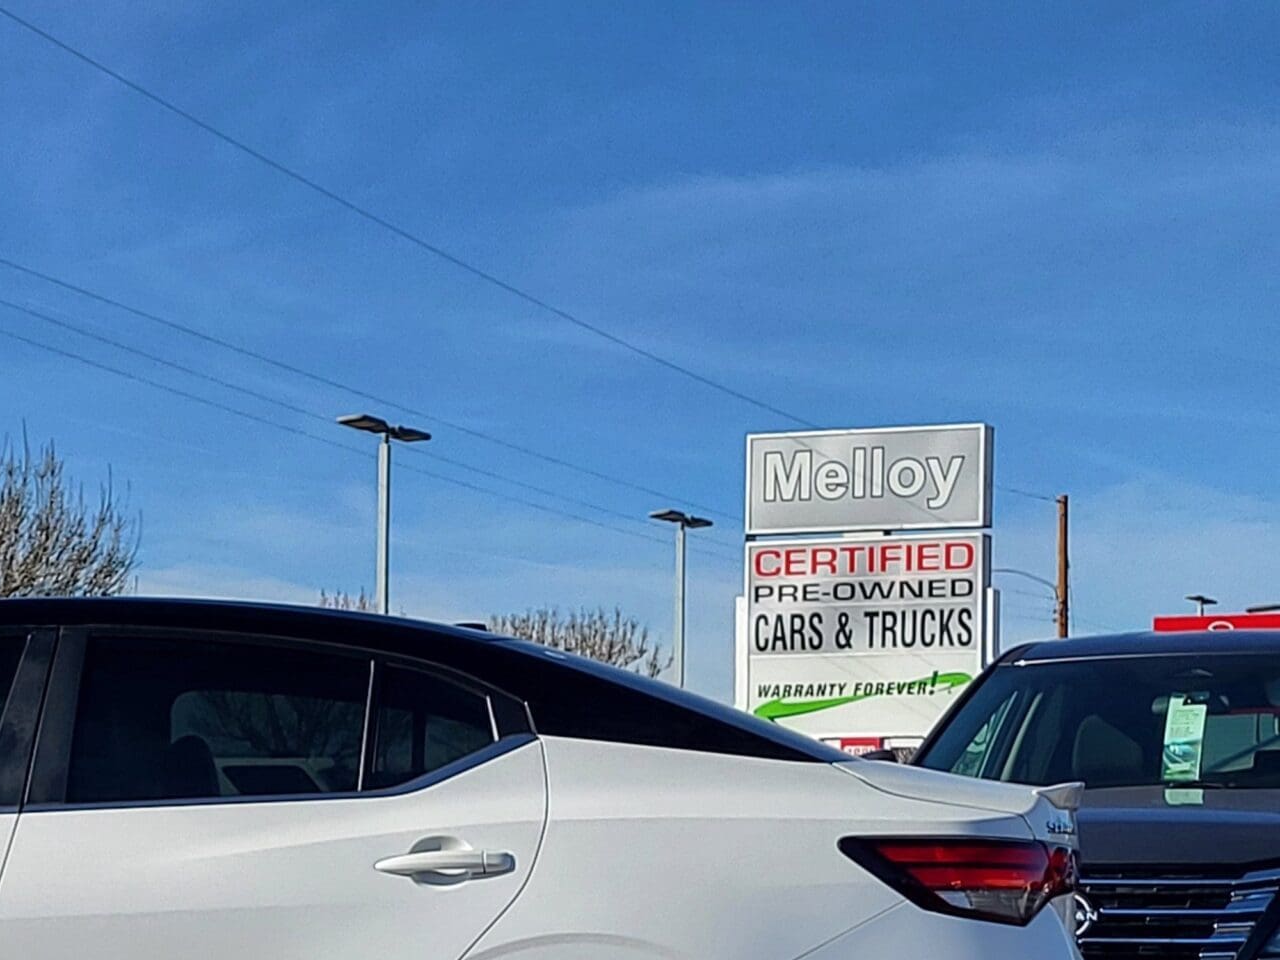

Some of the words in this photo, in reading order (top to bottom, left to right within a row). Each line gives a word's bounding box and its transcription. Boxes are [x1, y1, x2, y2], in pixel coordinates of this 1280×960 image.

[763, 446, 966, 510] Melloy
[754, 542, 975, 578] CERTIFIED
[754, 578, 974, 604] PRE-OWNED
[755, 612, 824, 652] CARS
[835, 612, 853, 650] &
[864, 608, 973, 648] TRUCKS
[757, 682, 847, 698] WARRANTY
[853, 670, 938, 697] FOREVER!
